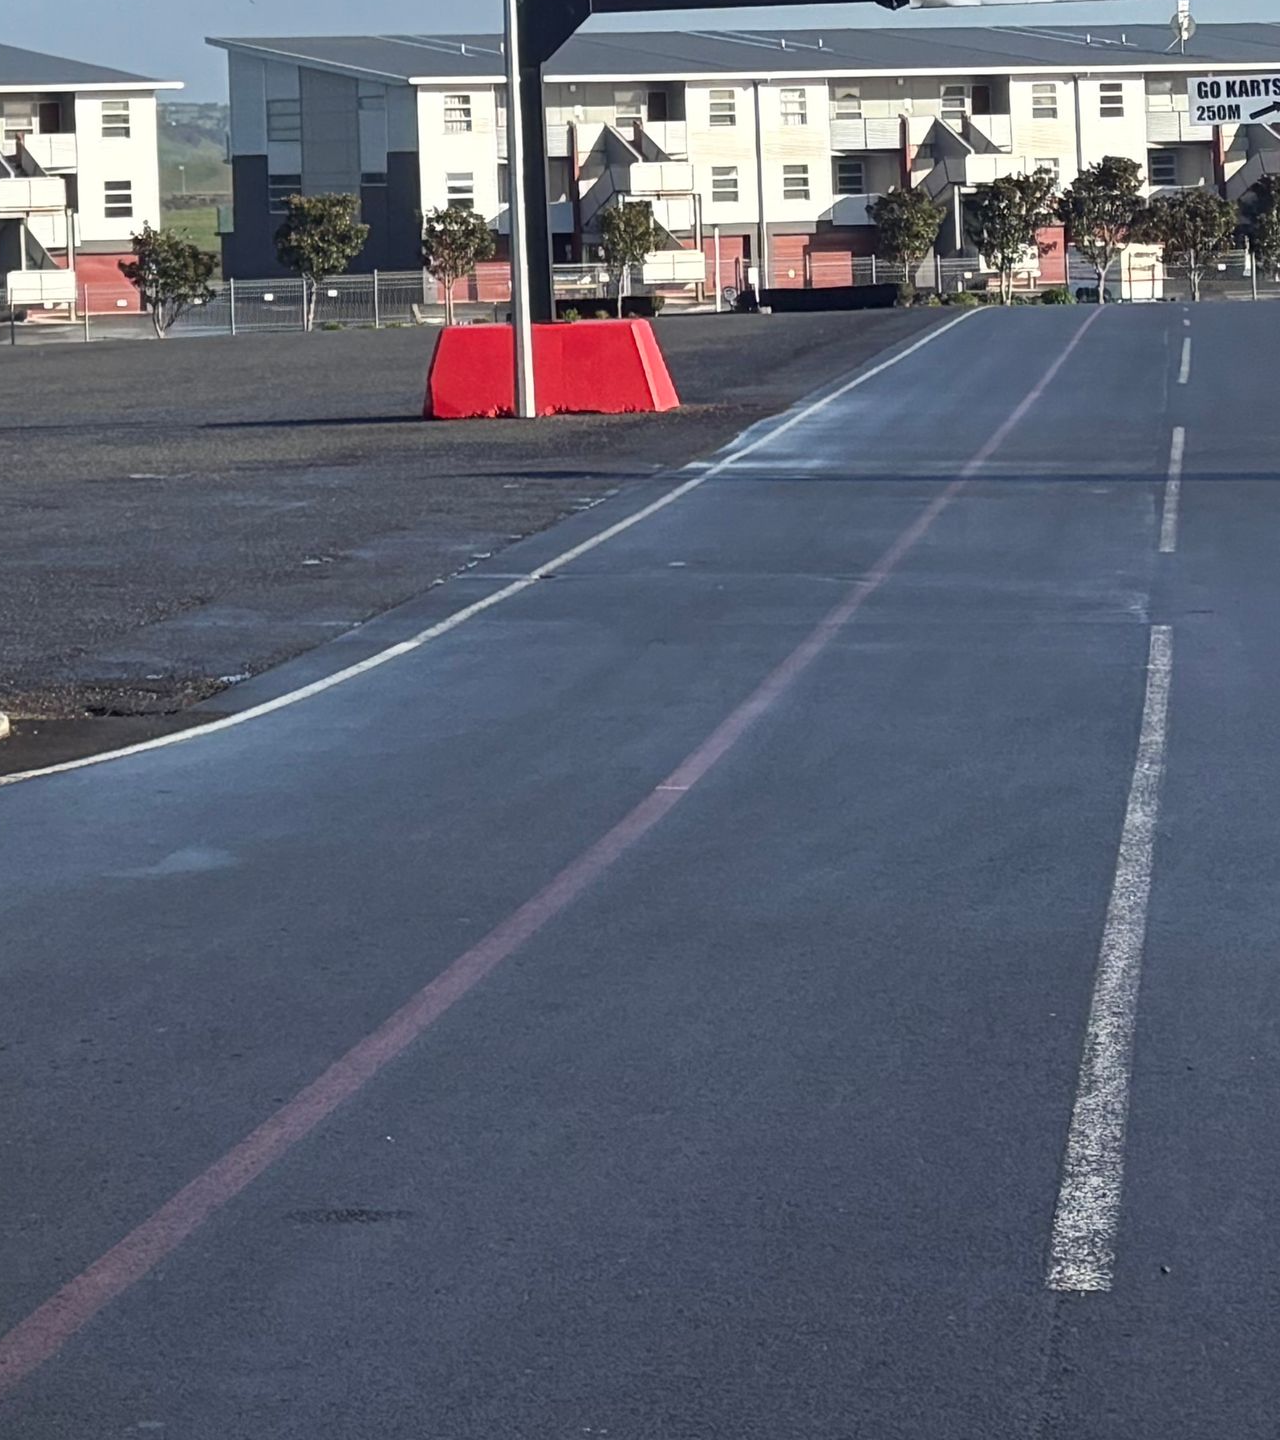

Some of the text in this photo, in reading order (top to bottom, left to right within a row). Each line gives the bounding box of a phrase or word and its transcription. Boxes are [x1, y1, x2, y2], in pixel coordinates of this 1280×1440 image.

[1197, 77, 1280, 100] GO KARTS
[1196, 104, 1241, 122] 250M
